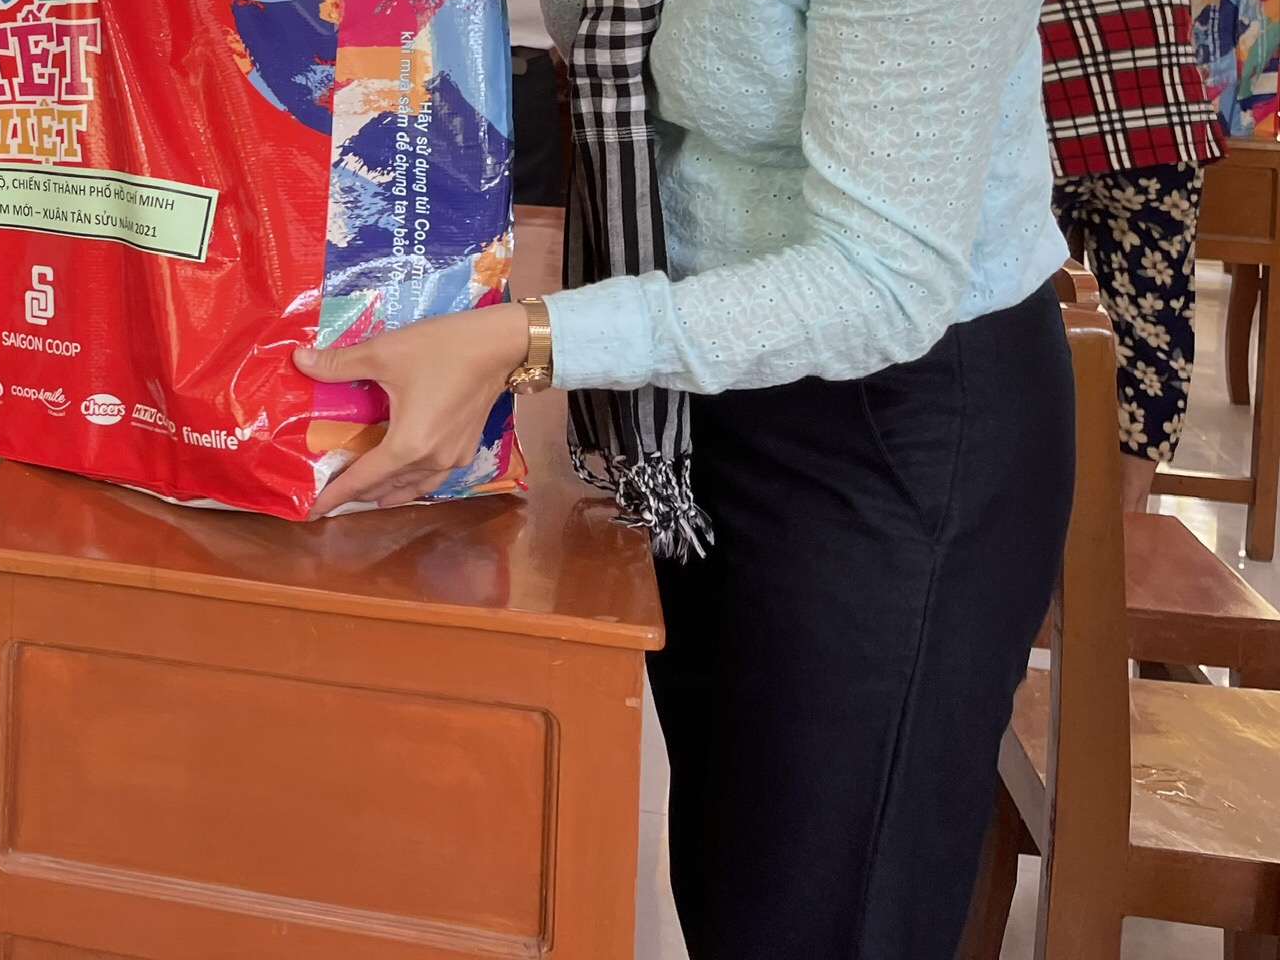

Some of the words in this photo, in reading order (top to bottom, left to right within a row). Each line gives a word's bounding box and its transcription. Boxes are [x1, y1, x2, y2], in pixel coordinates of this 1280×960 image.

[401, 31, 415, 54] khi
[400, 59, 412, 91] mua
[396, 96, 413, 128] sắm
[414, 102, 432, 132] Hãy
[395, 131, 413, 152] để
[415, 136, 432, 156] sử
[391, 153, 409, 196] chung
[412, 158, 430, 193] dụng
[12, 176, 40, 191] CHIẾN
[42, 178, 51, 192] SĨ
[53, 181, 86, 197] THÀNH
[89, 183, 112, 198] PHỐ
[114, 185, 125, 201] HỒ
[126, 190, 137, 205] CHÍ
[139, 194, 175, 211] MINH
[415, 196, 430, 215] túi
[12, 203, 33, 217] MỚI
[42, 207, 68, 222] XUÂN
[70, 209, 92, 225] TÂN
[94, 210, 118, 227] SỬU
[119, 217, 135, 232] NĂM
[135, 222, 158, 238] 2021
[391, 200, 409, 225] tay
[392, 228, 409, 256] bảo
[1, 330, 43, 352] SAIGON
[45, 338, 81, 357] CO.OP
[80, 397, 126, 418] Cheers
[182, 426, 239, 450] finelife
